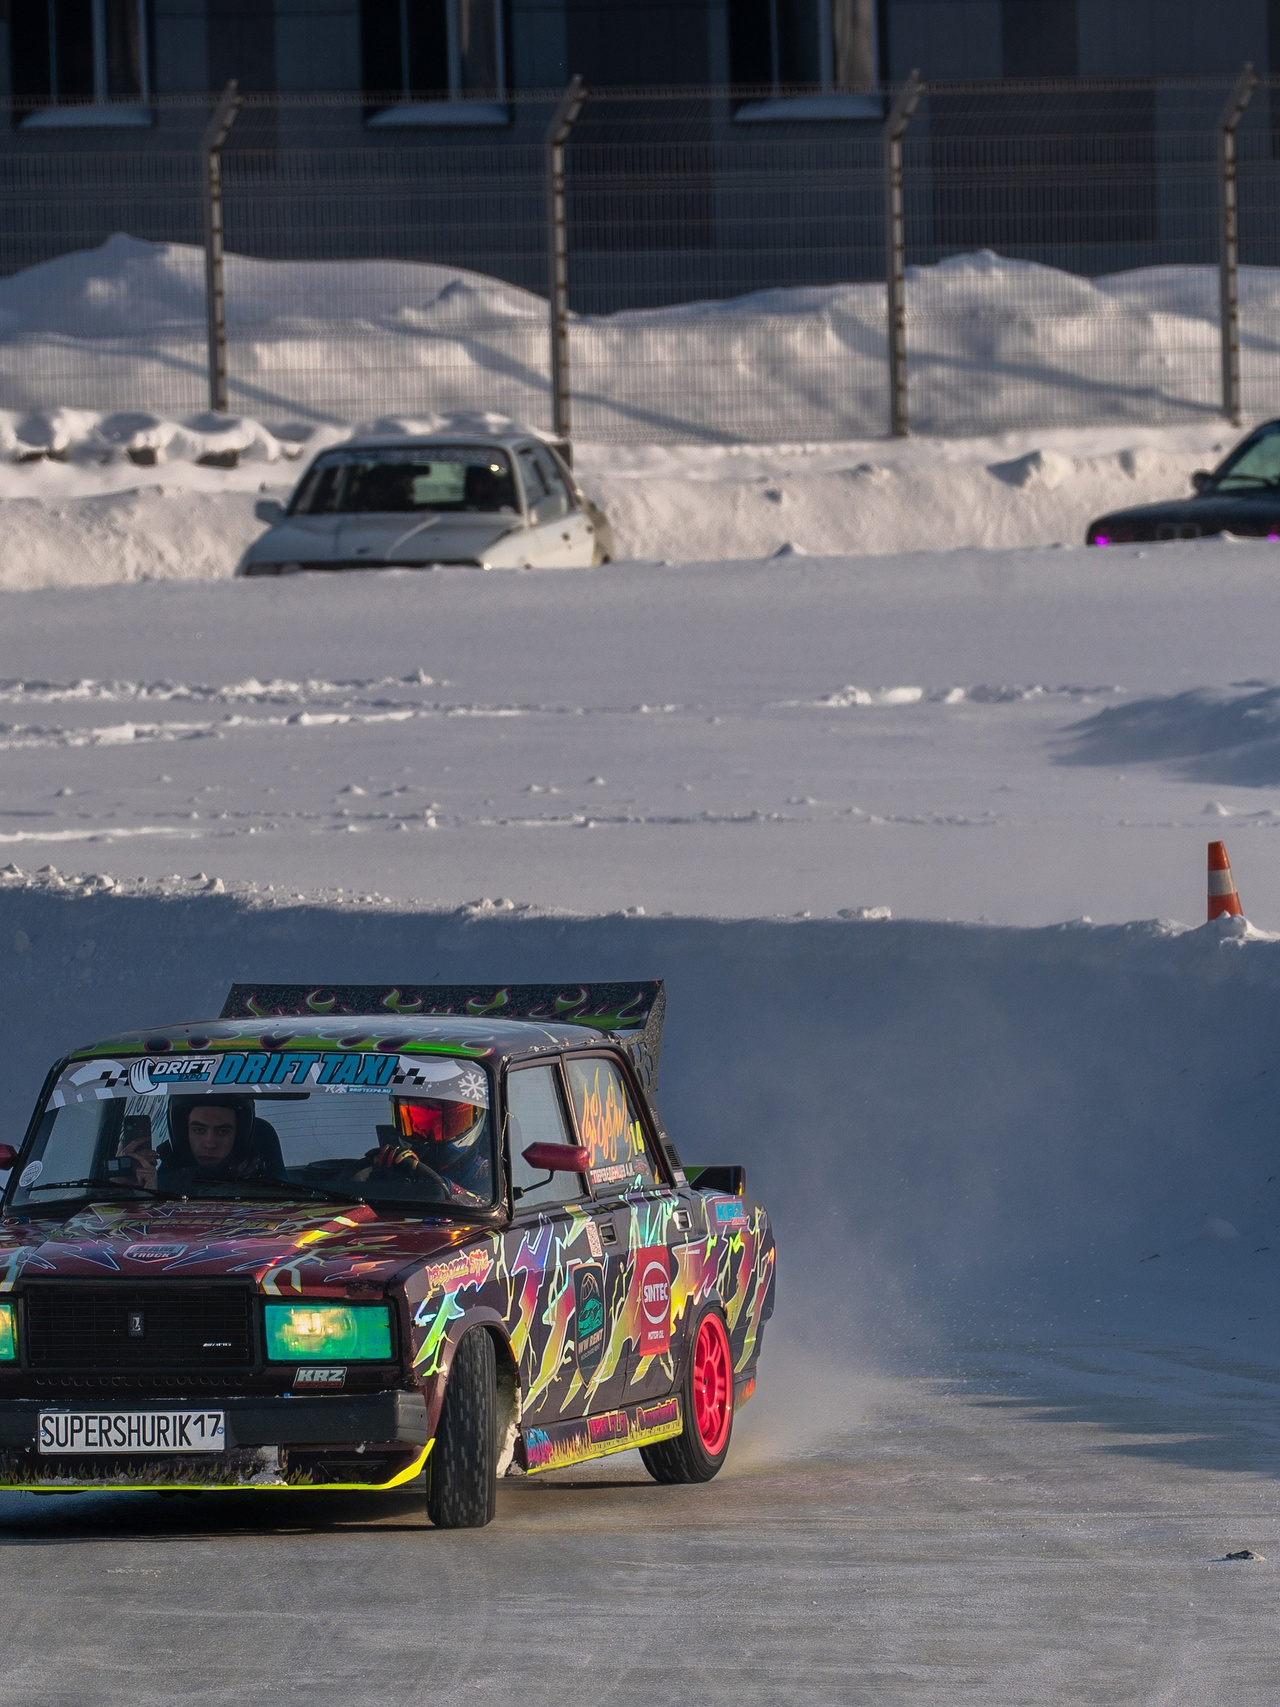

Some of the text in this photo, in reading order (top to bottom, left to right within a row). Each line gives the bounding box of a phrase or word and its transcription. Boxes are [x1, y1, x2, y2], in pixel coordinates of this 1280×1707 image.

[153, 1058, 215, 1075] DRIFT
[212, 1052, 400, 1086] DRIFT TAXI
[177, 1073, 204, 1081] EXPO
[643, 1282, 669, 1304] SINTEC
[297, 1369, 345, 1382] KRZ
